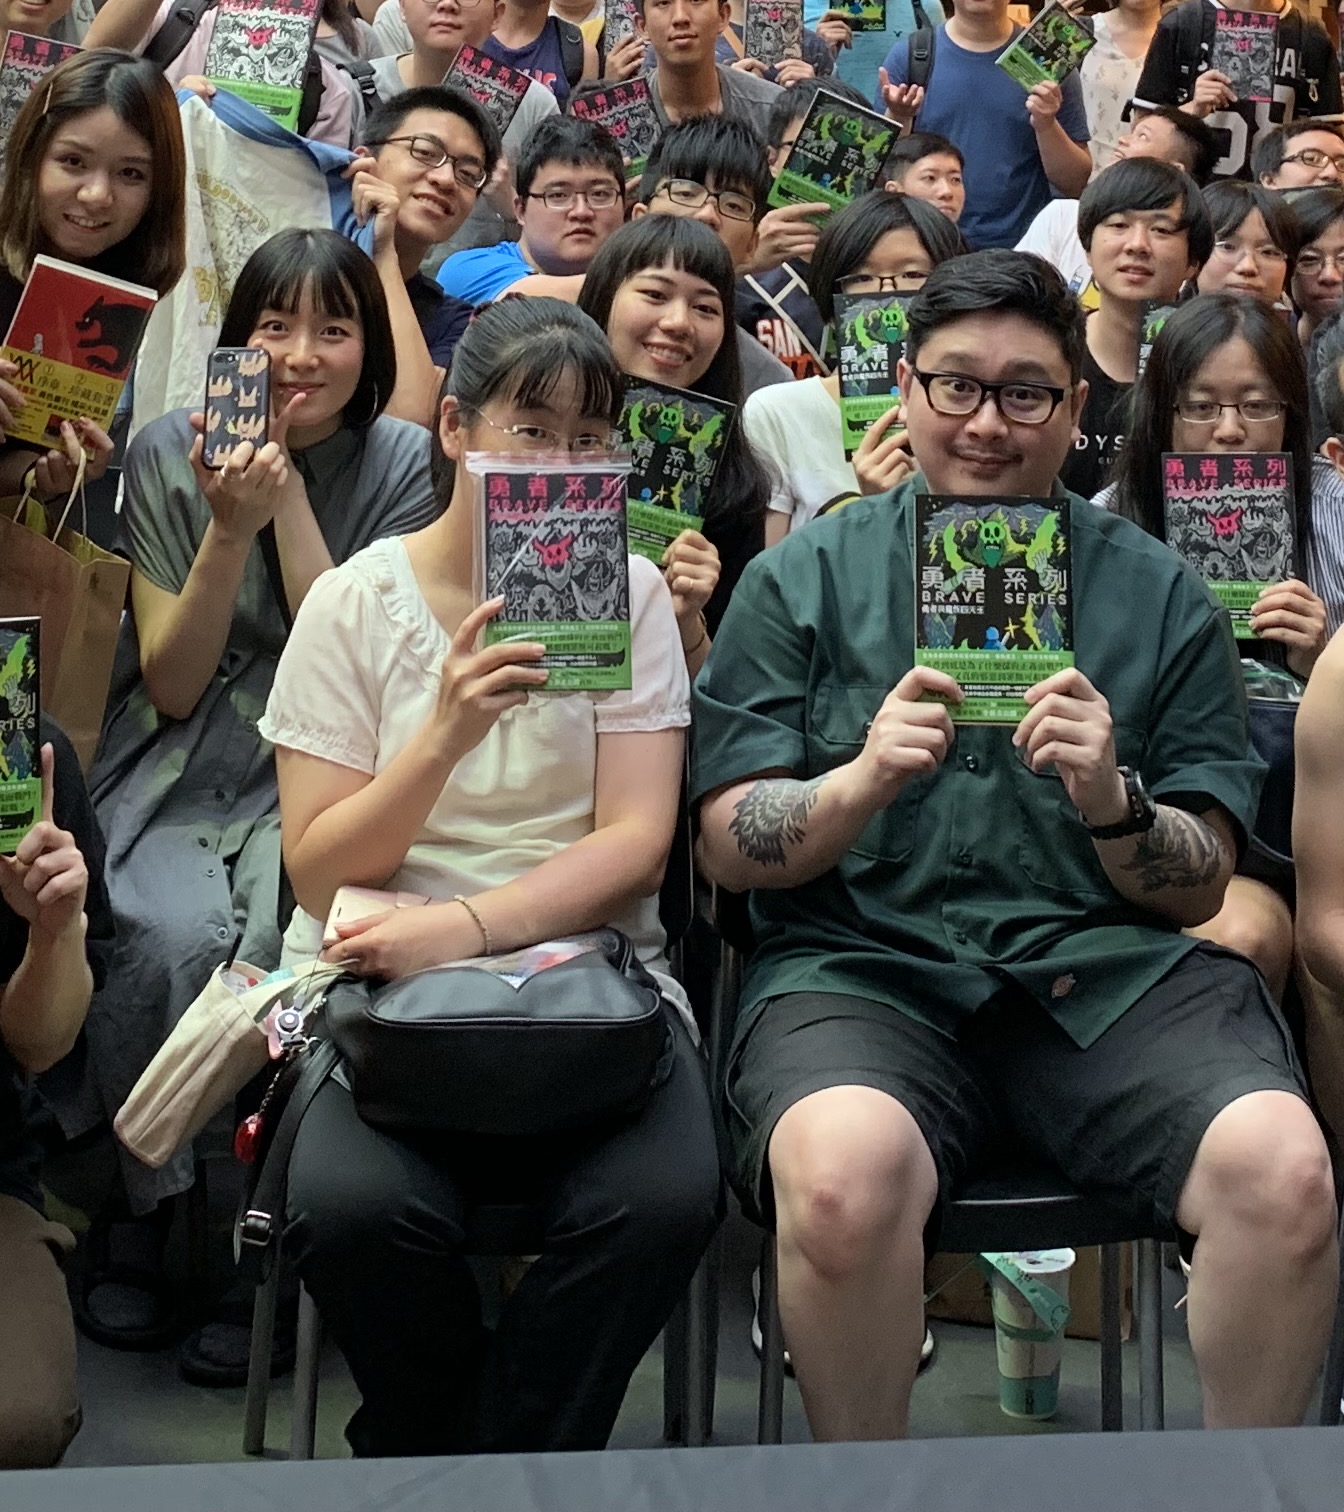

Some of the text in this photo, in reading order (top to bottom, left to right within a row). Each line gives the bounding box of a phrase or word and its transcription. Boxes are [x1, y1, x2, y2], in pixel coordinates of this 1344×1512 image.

[841, 361, 888, 373] BRAVE
[662, 465, 712, 487] SERIES
[1165, 458, 1287, 477] 勇者系列
[489, 475, 622, 498] 勇者系列
[921, 565, 1067, 592] 勇者系列
[922, 592, 1067, 604] BRAVE SERIES
